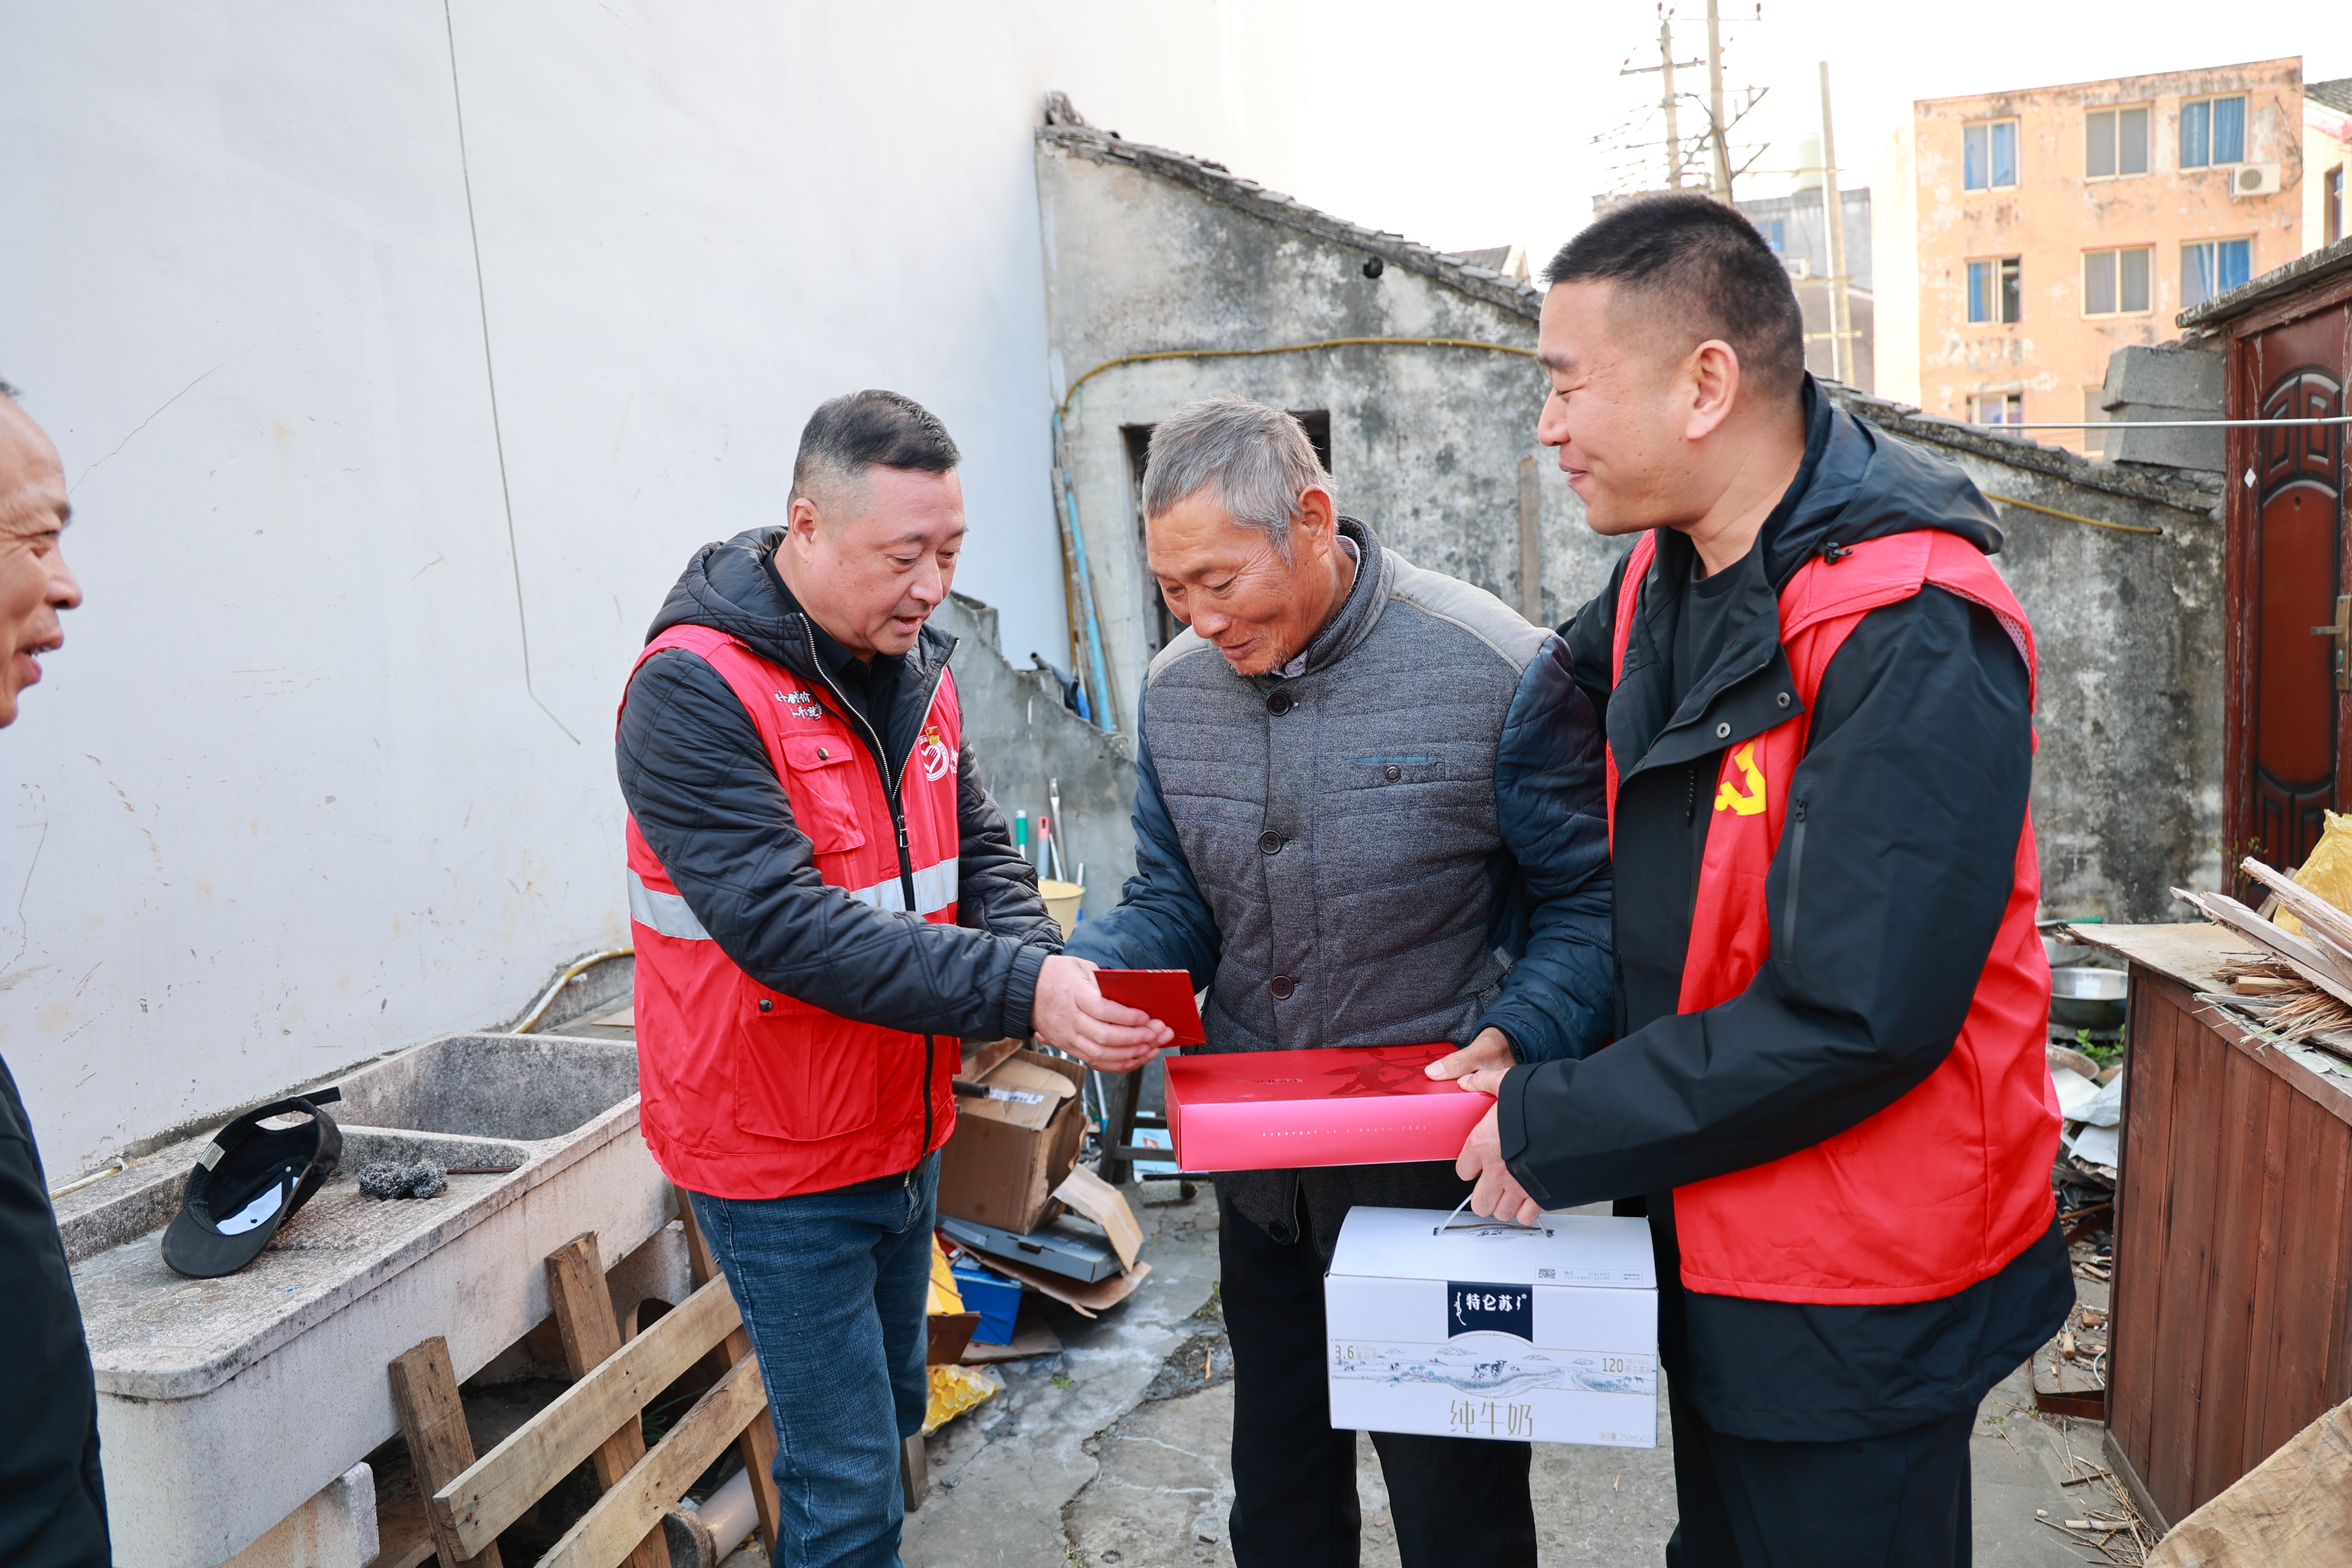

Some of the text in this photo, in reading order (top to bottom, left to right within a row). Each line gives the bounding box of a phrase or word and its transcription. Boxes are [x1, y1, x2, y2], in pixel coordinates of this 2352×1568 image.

[1466, 1293, 1513, 1312] 特仑苏
[1335, 1345, 1354, 1360] 3.6
[1602, 1358, 1623, 1373] 120
[1450, 1400, 1533, 1437] 纯牛奶
